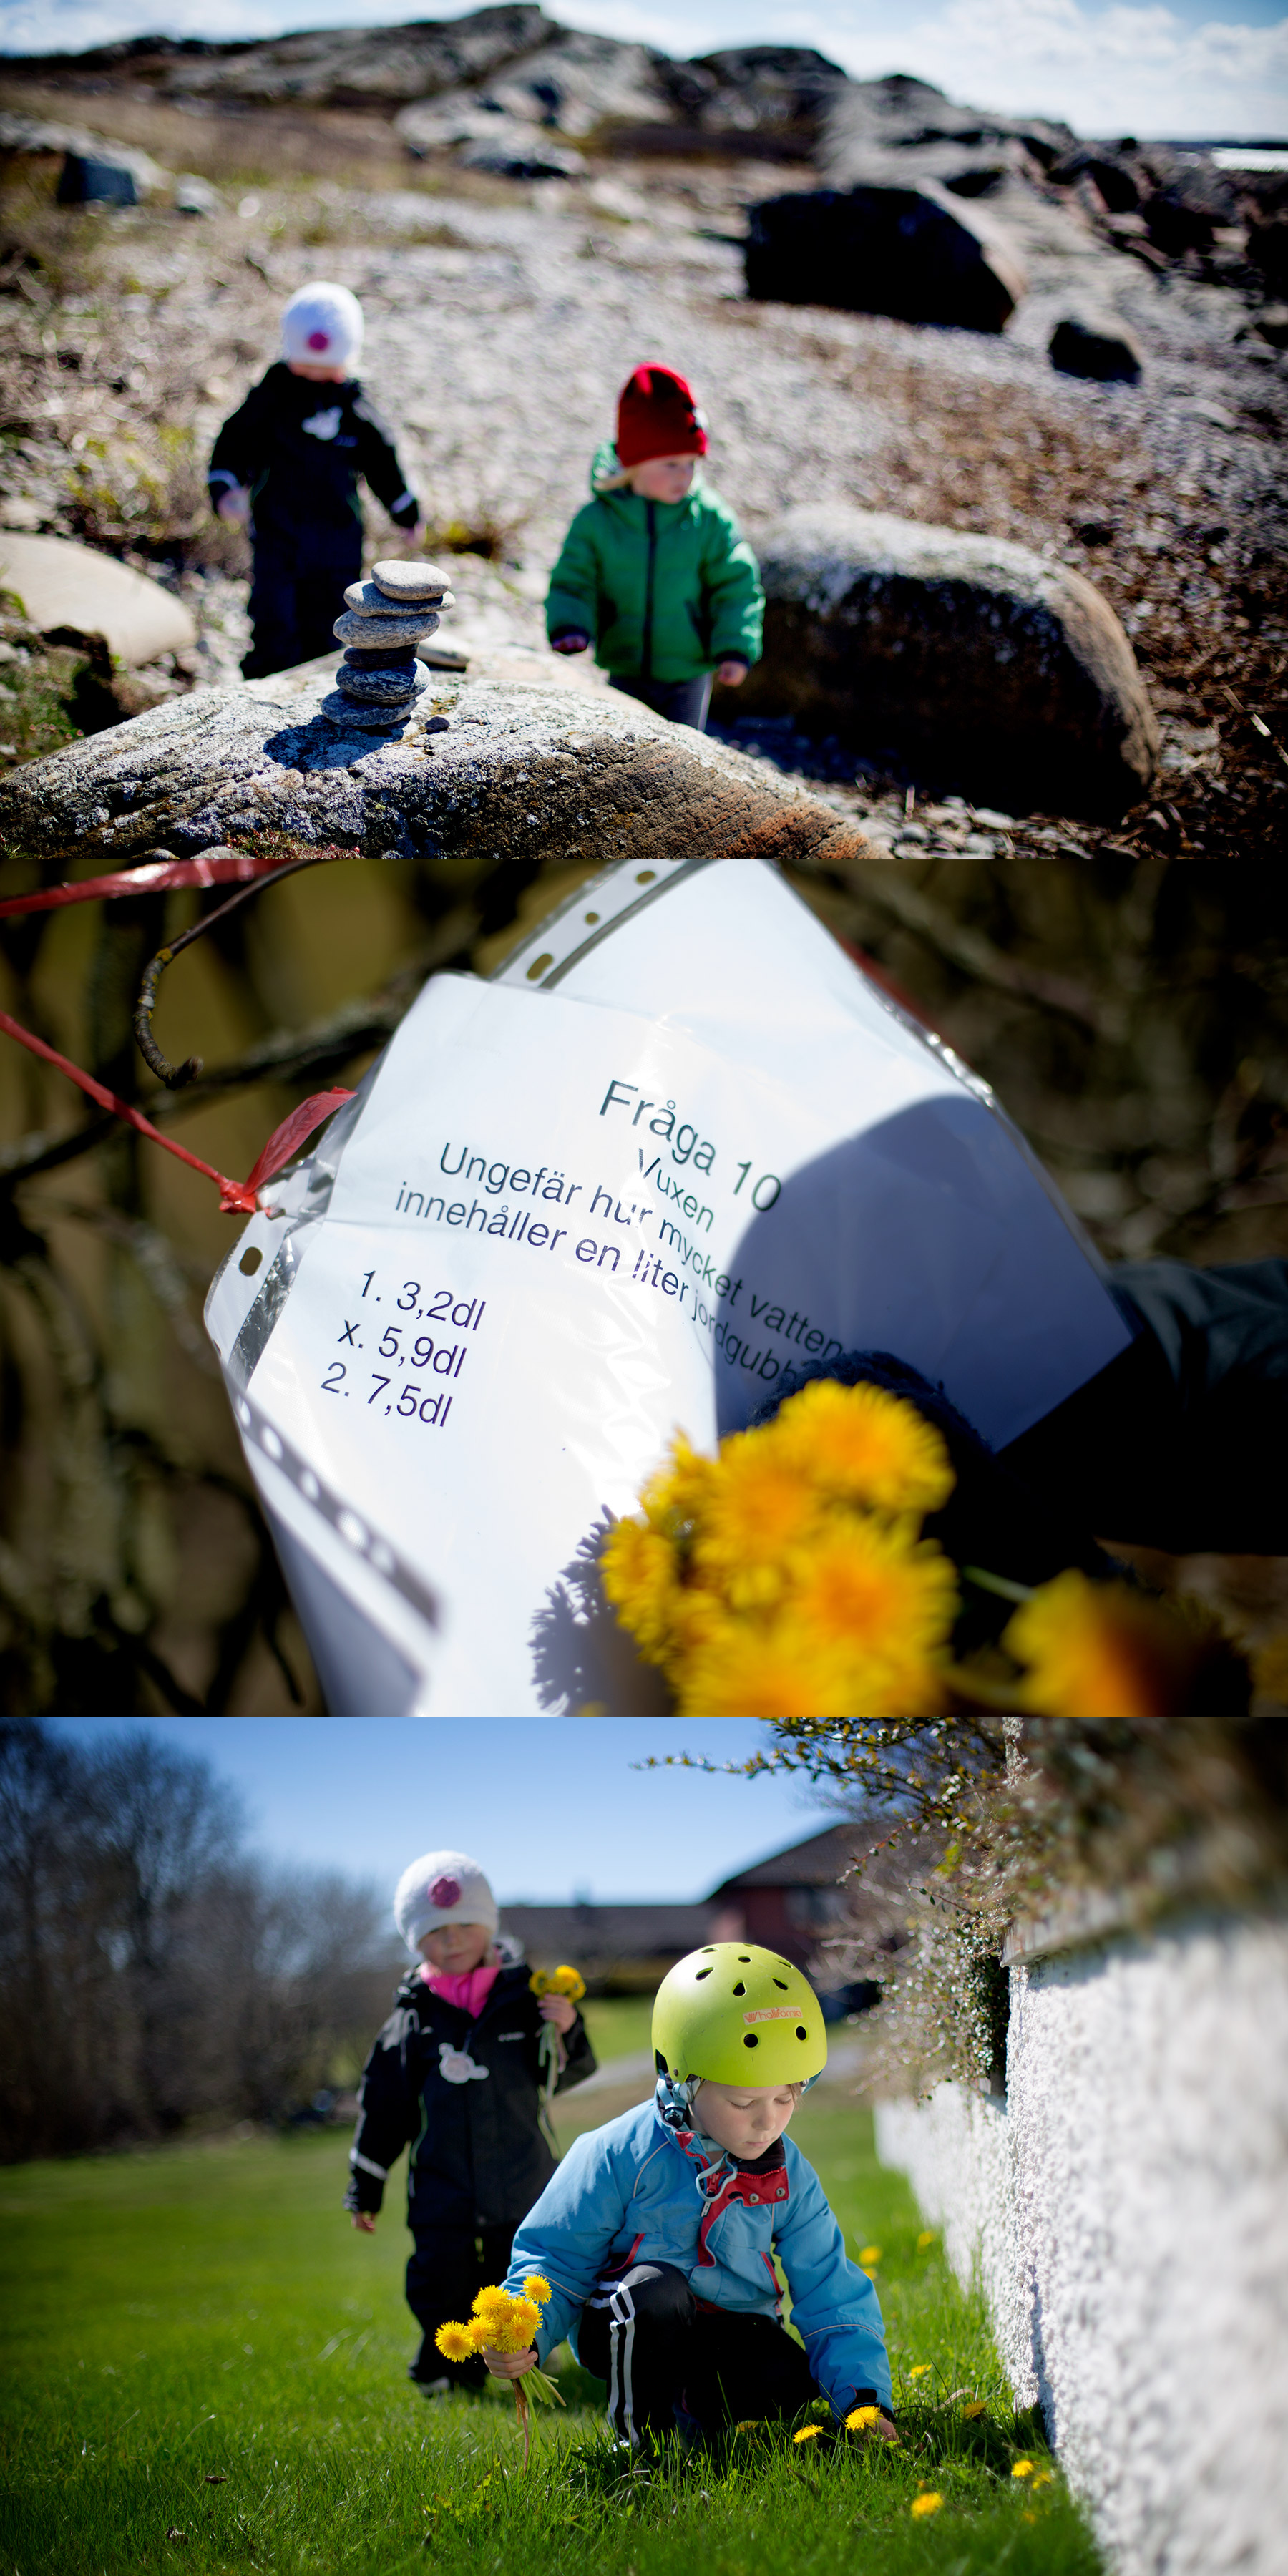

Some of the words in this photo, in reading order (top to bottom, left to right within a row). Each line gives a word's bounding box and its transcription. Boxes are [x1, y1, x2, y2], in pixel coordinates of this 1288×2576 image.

[599, 1080, 716, 1176] Fråga
[733, 1161, 781, 1212] 10
[638, 1148, 714, 1233] Vuxen
[395, 1181, 567, 1252] innehåller
[575, 1237, 621, 1271] en
[632, 1249, 688, 1302] liter
[440, 1142, 582, 1205] Ungefär
[589, 1184, 653, 1226] hur
[659, 1219, 743, 1306] mycket
[751, 1294, 843, 1357] vatten
[361, 1270, 381, 1302] 1.
[396, 1281, 487, 1330] 3,2dl
[337, 1319, 364, 1348] x.
[379, 1326, 467, 1378] 5,9dl
[320, 1362, 349, 1397] 2.
[366, 1373, 453, 1427] 7,5dl
